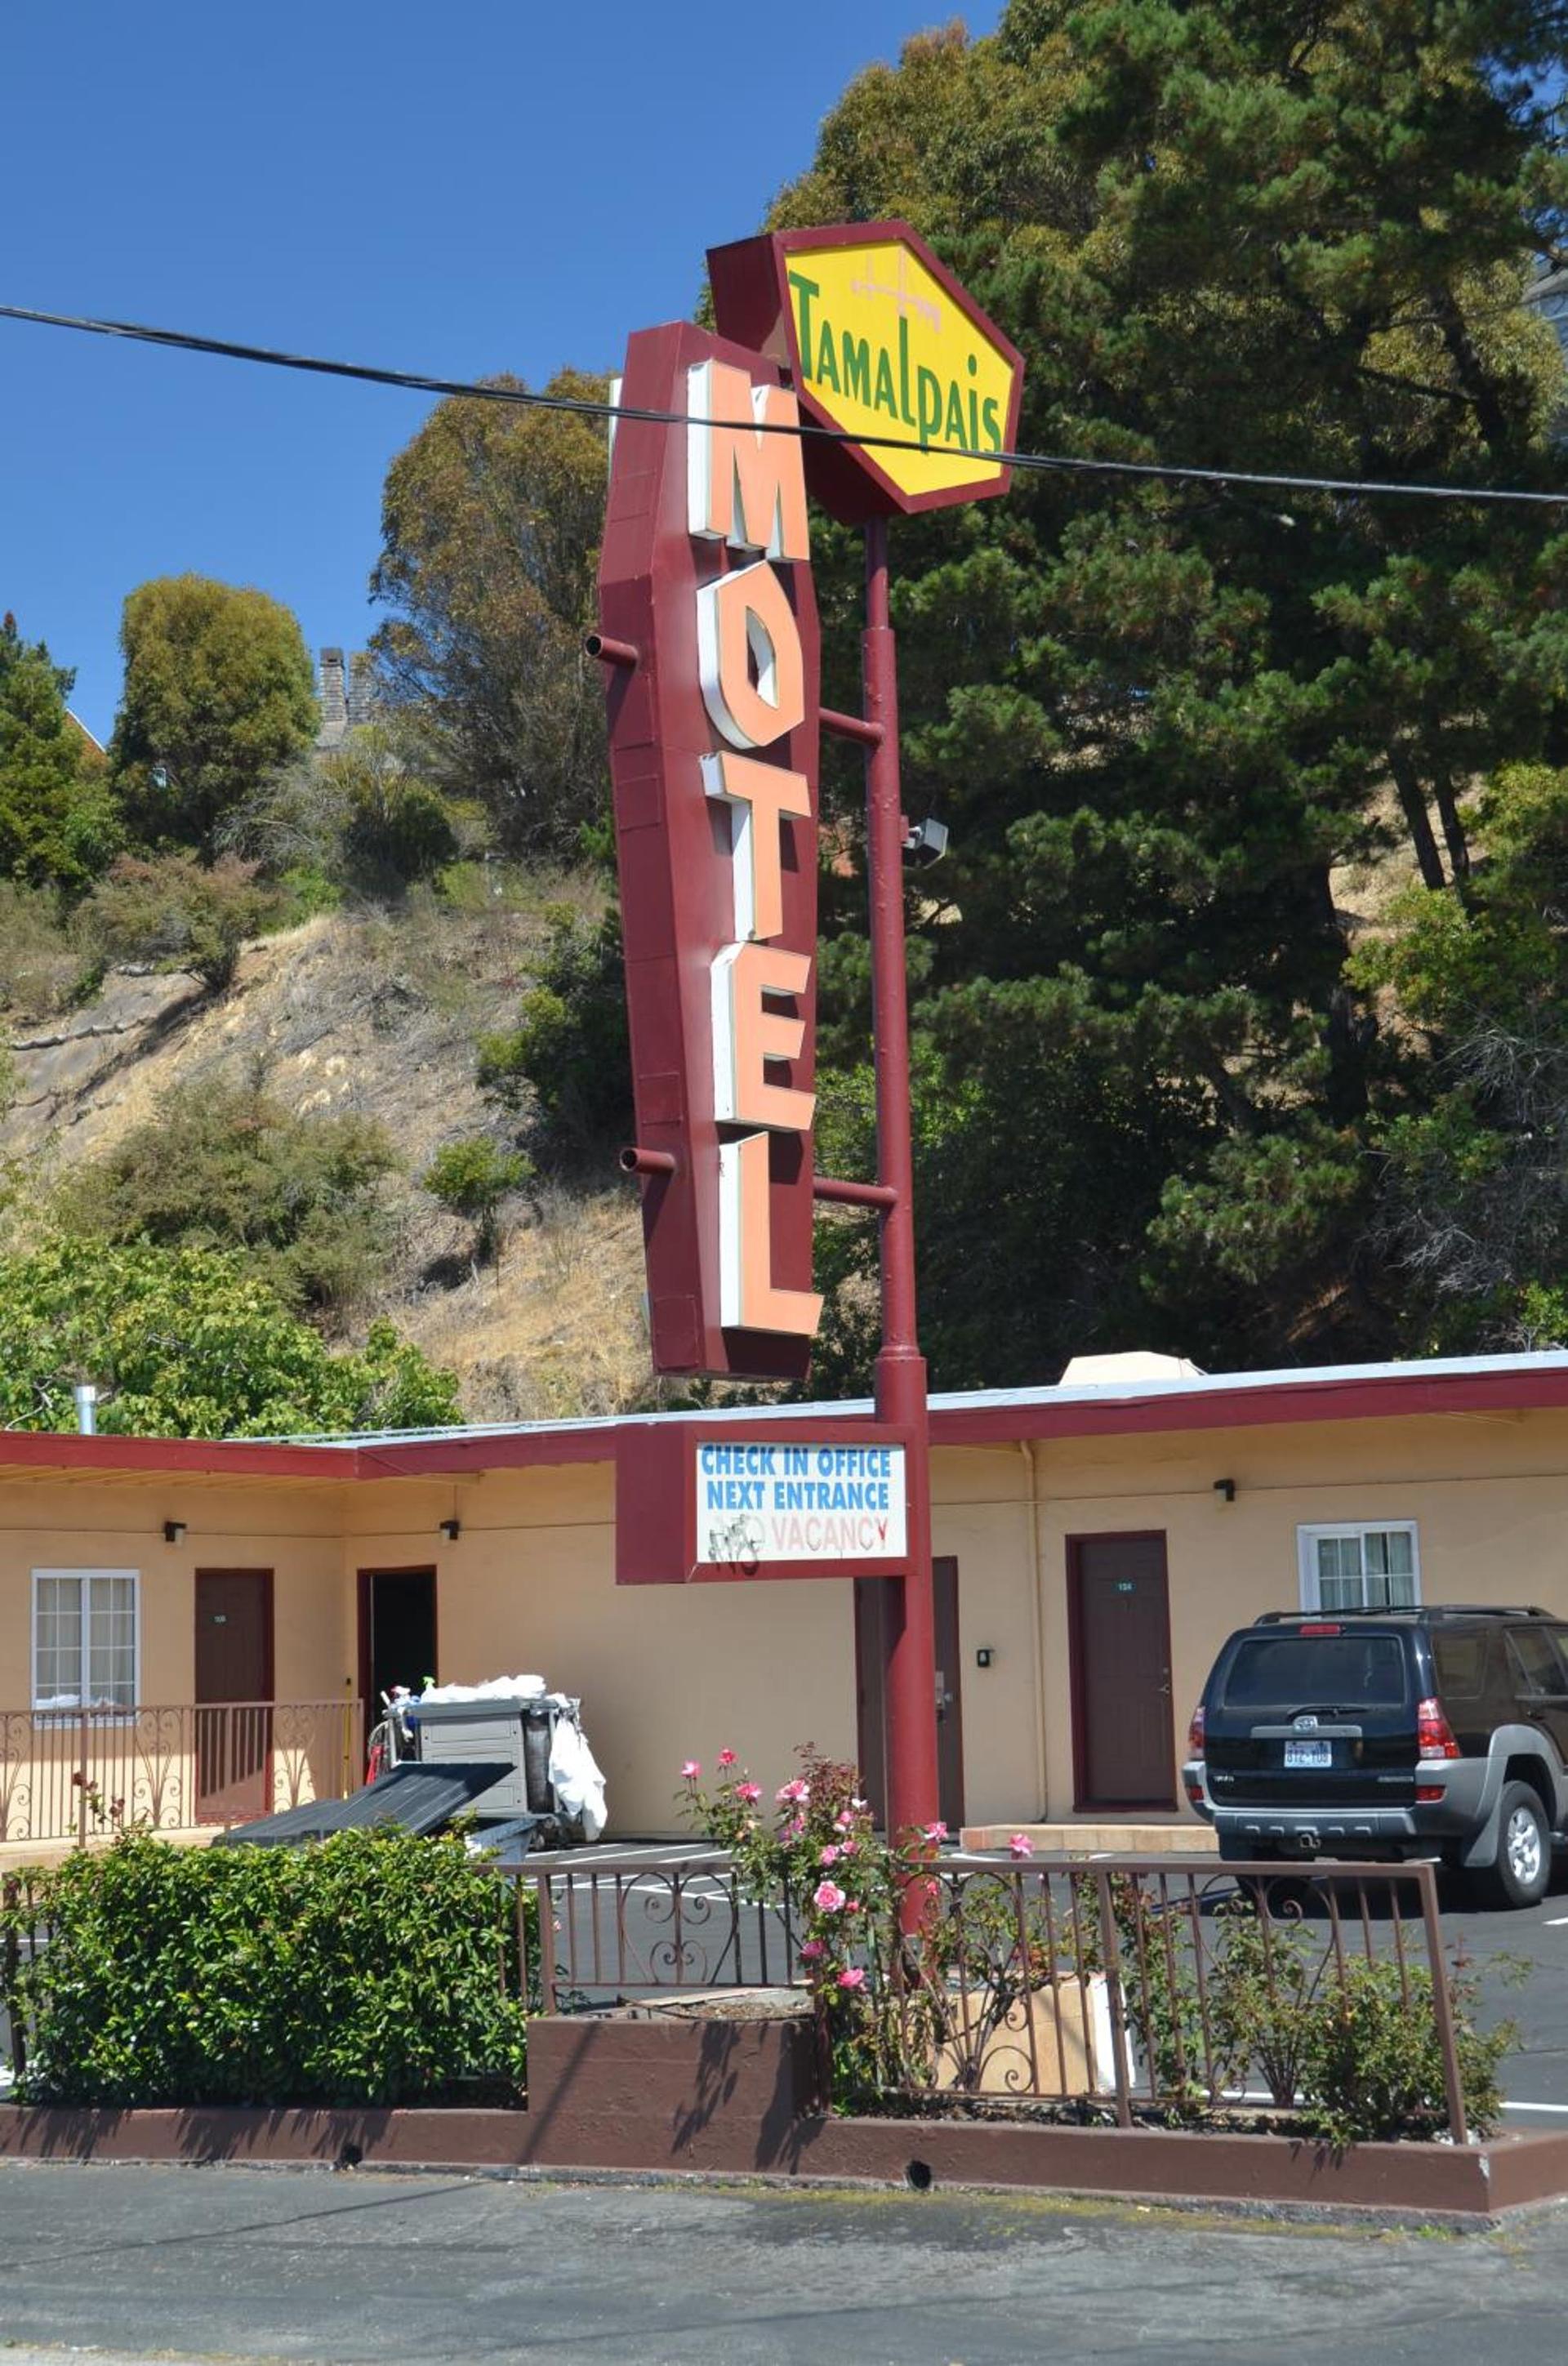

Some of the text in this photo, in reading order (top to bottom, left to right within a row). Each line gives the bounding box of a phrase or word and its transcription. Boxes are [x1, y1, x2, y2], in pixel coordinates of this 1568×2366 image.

[687, 359, 823, 1338] MOTEL
[702, 1445, 891, 1477] CHECK IN OFFICE
[706, 1481, 889, 1510] NEXT ENTRANCE
[770, 1517, 889, 1552] VACANCY
